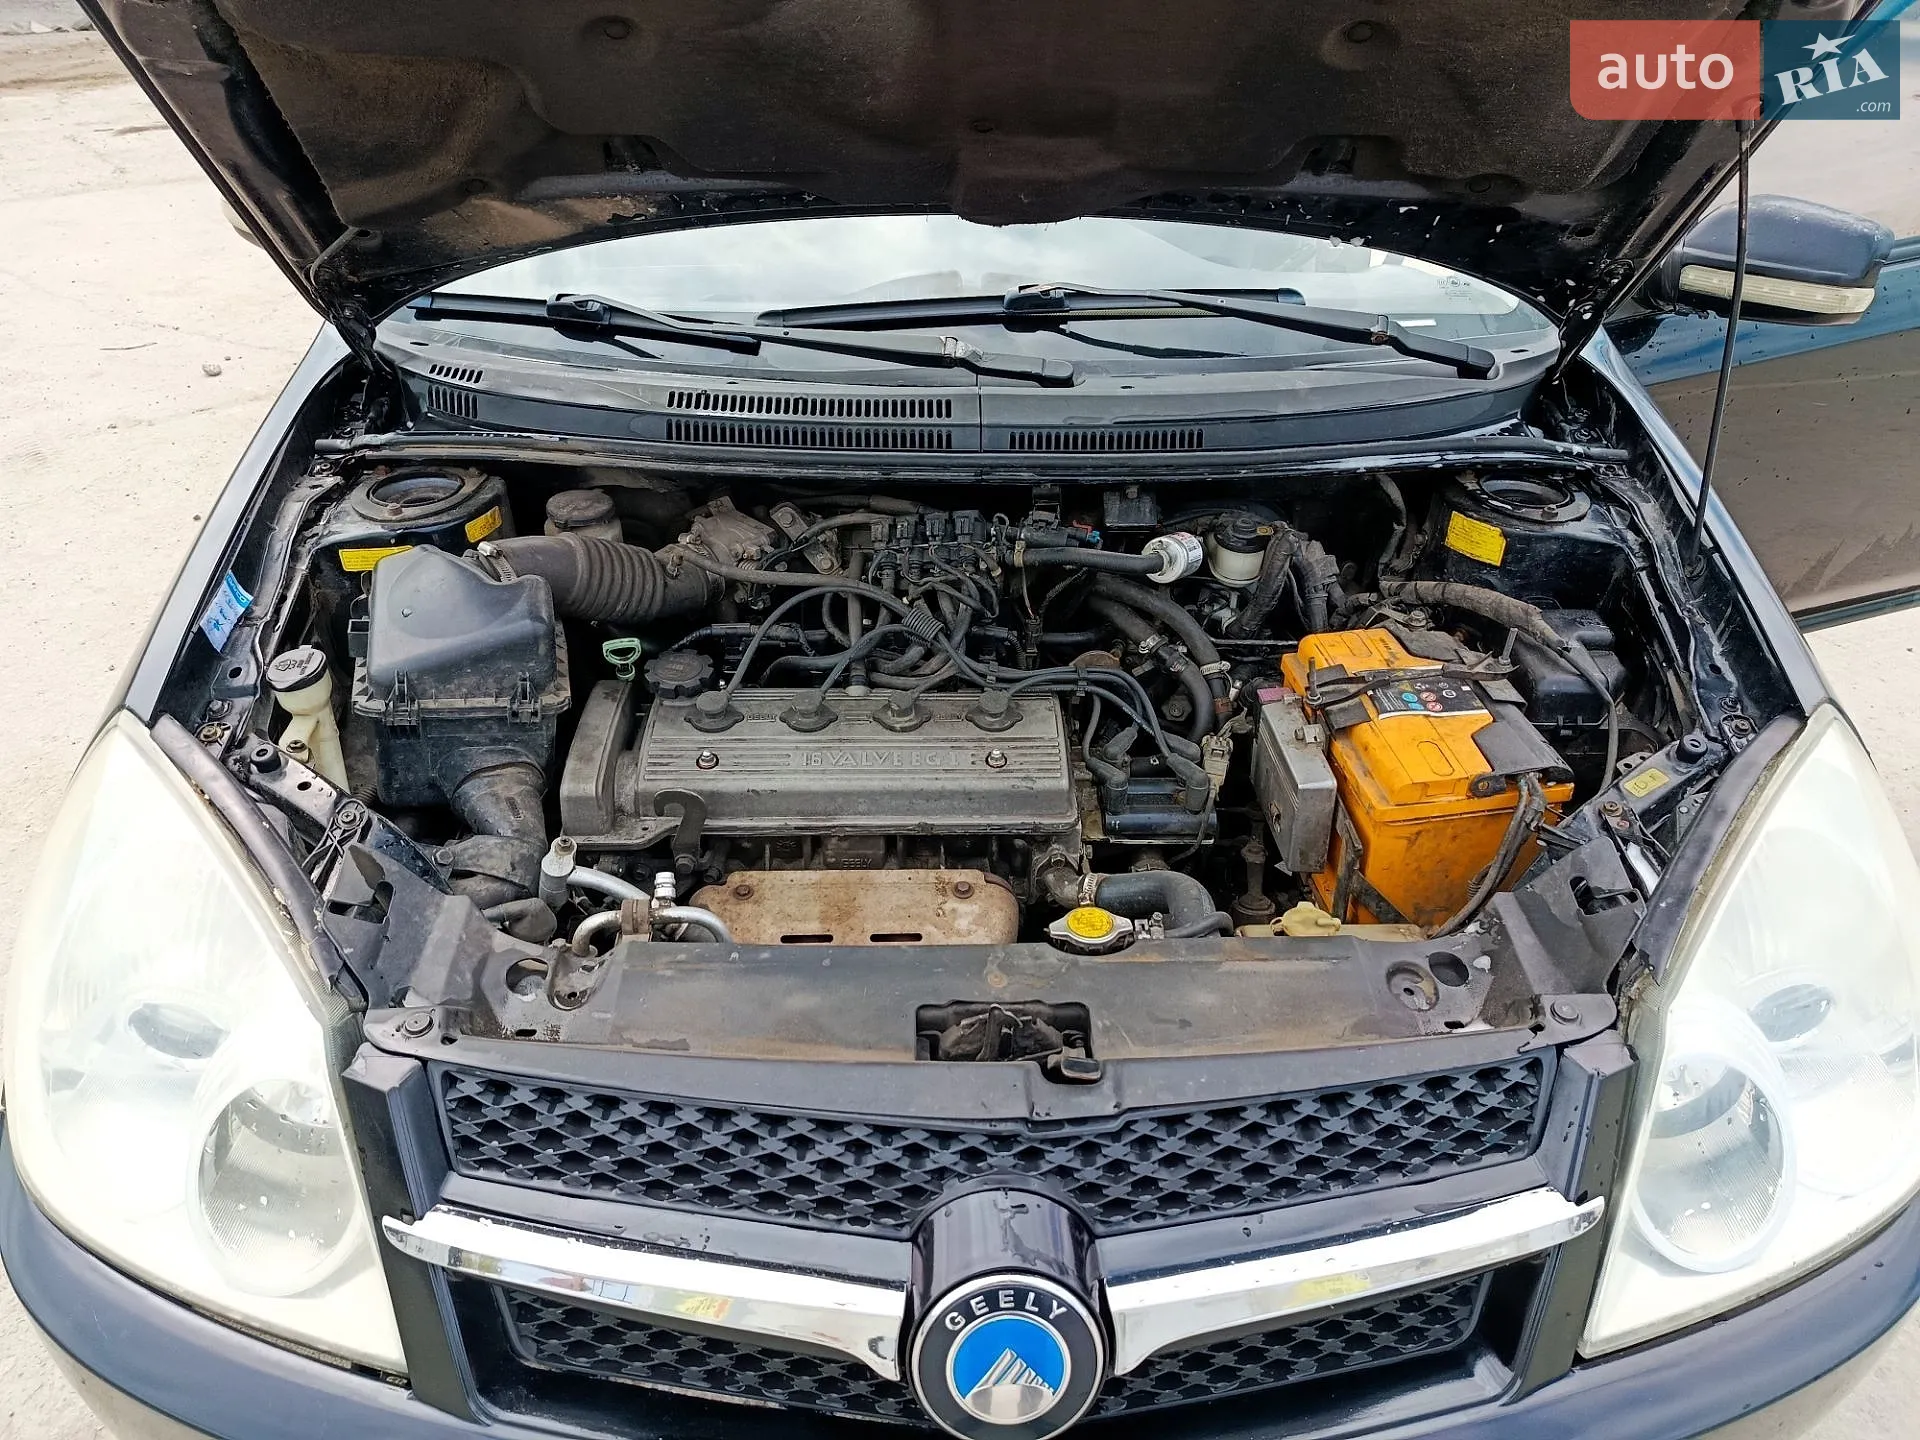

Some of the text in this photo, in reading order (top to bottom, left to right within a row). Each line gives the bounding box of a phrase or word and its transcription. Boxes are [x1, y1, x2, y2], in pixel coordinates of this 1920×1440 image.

[801, 751, 823, 767] 16
[827, 751, 904, 767] VALVE
[944, 1289, 1069, 1332] GEELY
